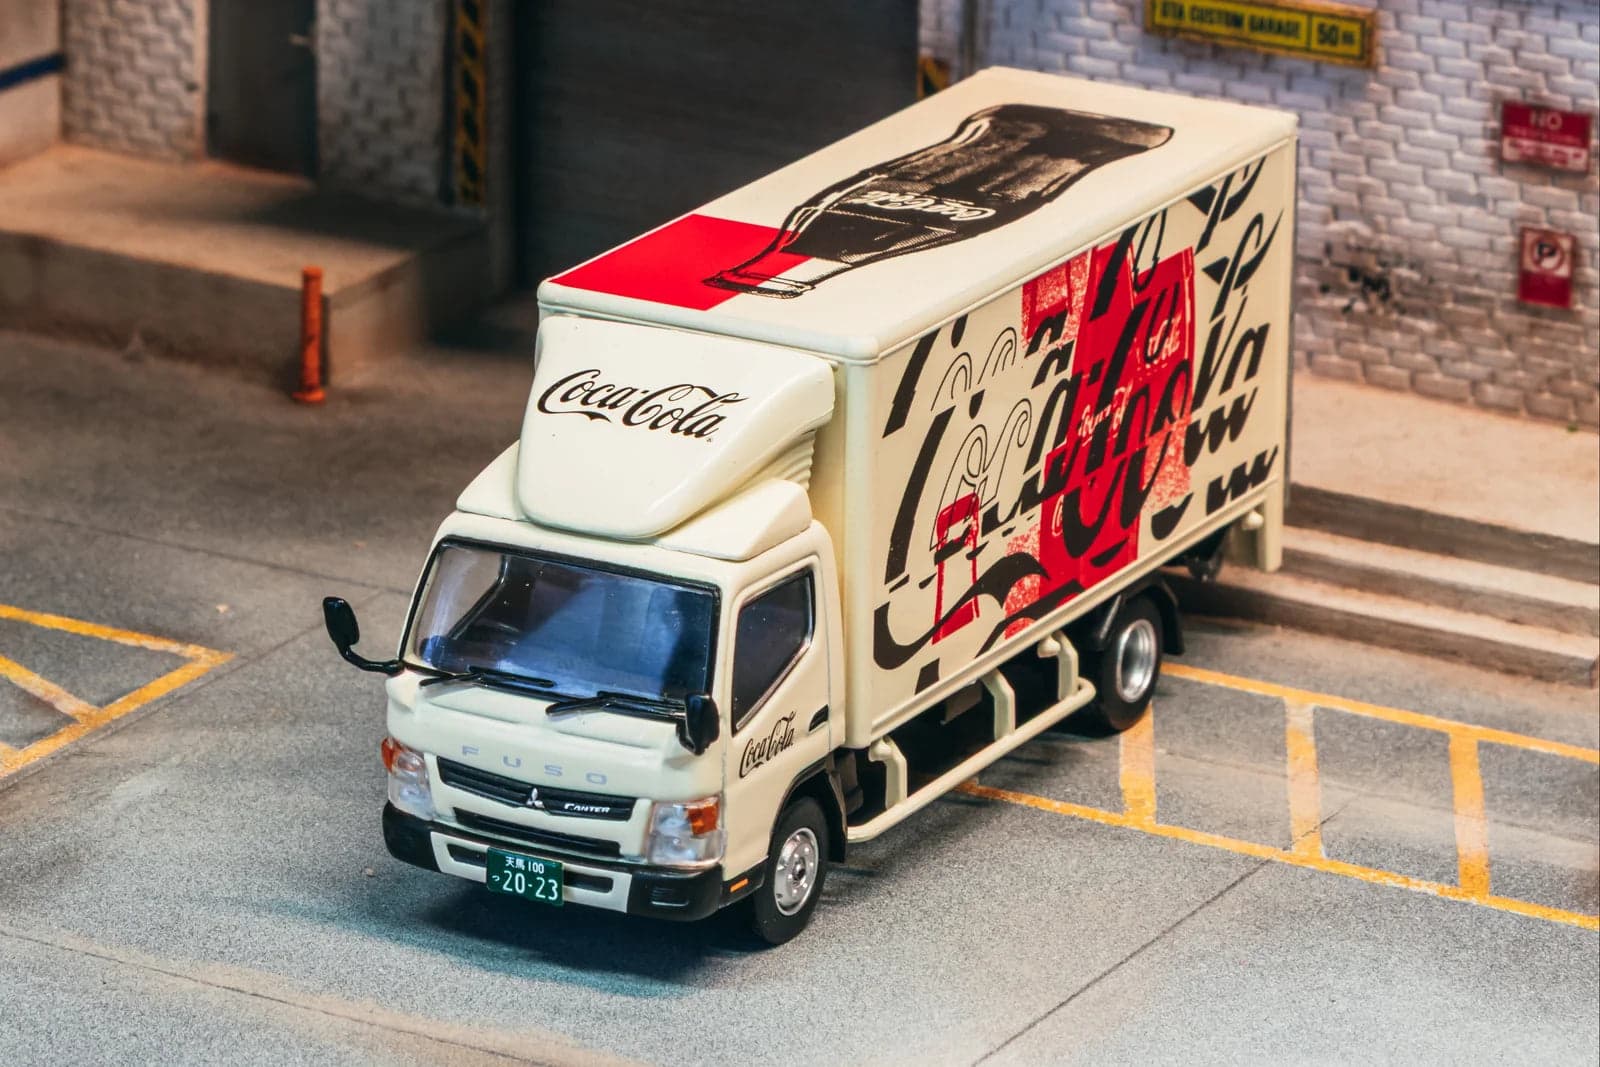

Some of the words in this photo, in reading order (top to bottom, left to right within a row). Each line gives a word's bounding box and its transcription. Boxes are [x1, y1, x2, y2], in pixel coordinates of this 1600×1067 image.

[462, 744, 608, 786] FUSO
[528, 860, 545, 874] 100
[502, 870, 559, 901] 20-23
